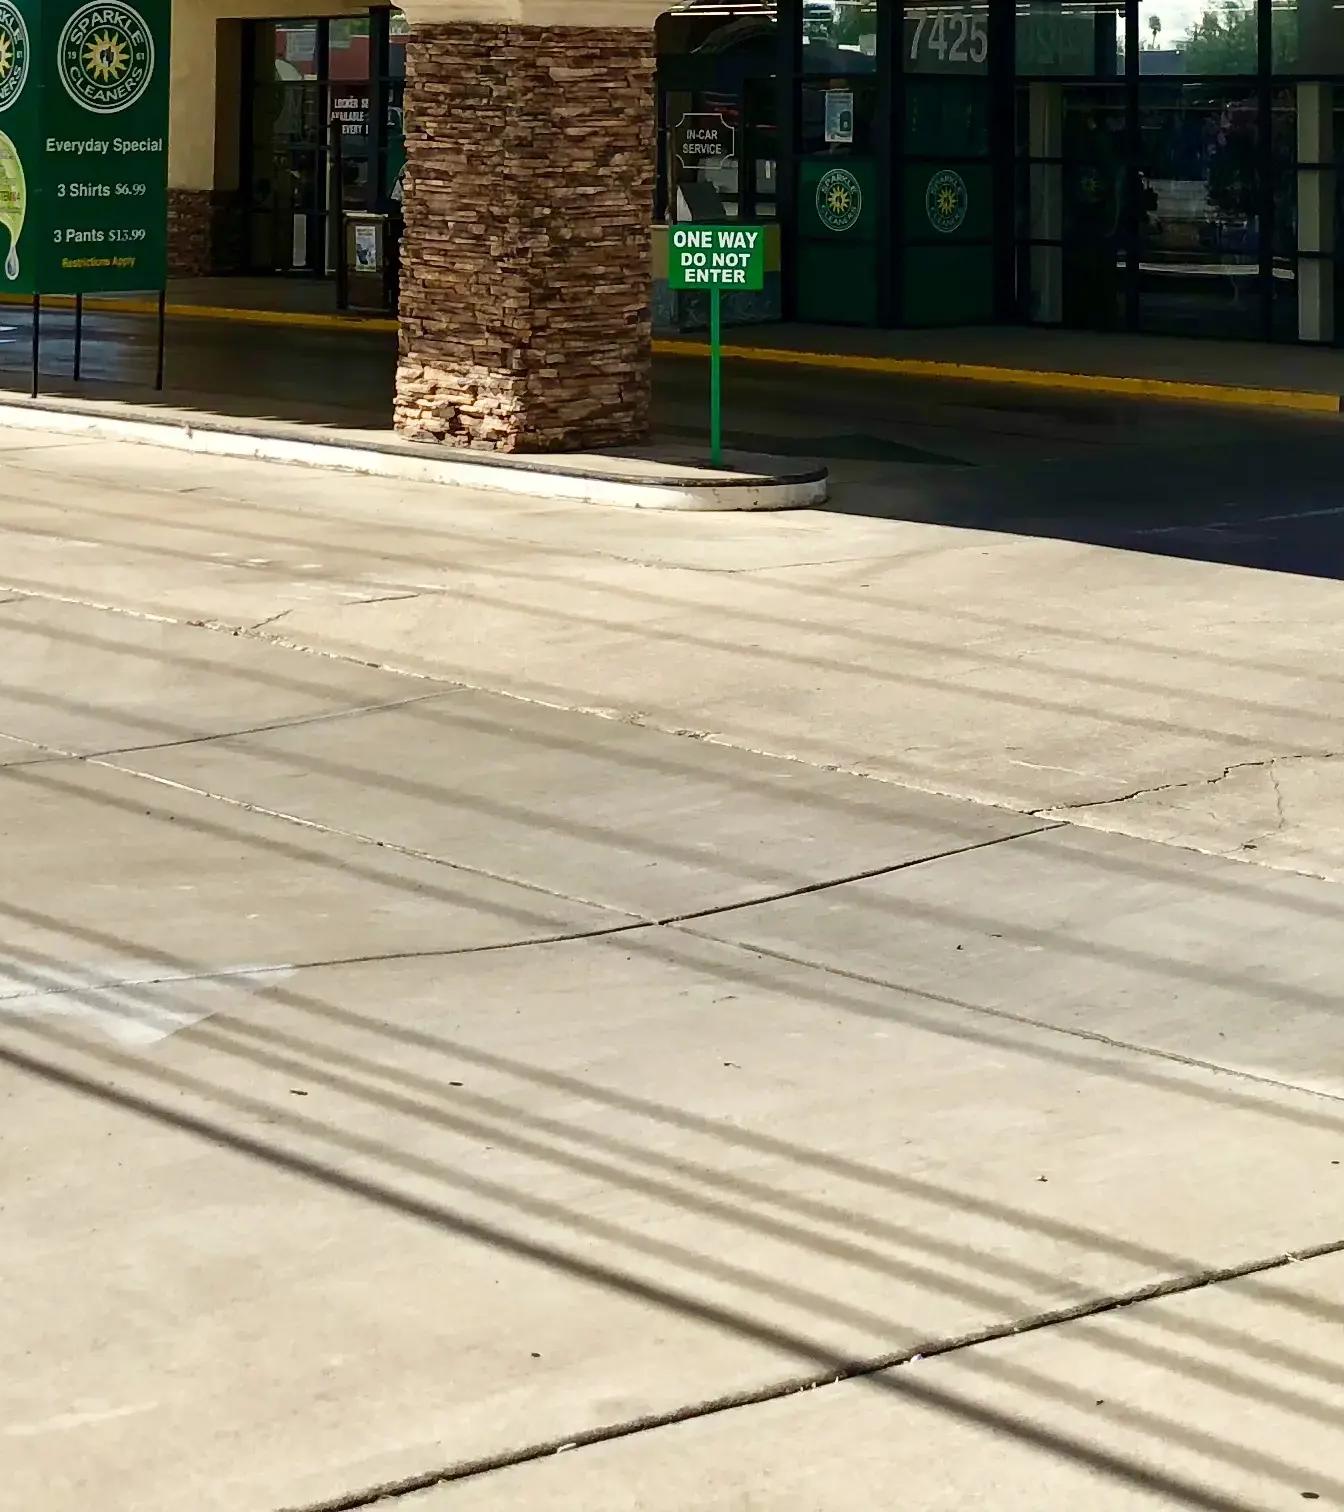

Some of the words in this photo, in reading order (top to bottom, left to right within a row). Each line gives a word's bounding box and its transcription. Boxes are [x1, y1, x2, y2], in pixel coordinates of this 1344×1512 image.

[70, 9, 144, 47] SPARKLE
[907, 10, 988, 63] 7425
[70, 66, 143, 102] CLEANERS
[686, 129, 718, 140] IN-CAR
[45, 137, 110, 155] Everyday
[113, 137, 163, 155] Special
[682, 143, 722, 155] SERVICE
[57, 183, 66, 197] 3
[69, 183, 111, 197] Shirts
[114, 183, 147, 196] $6.99
[53, 229, 63, 243] 3
[65, 228, 105, 242] Pants
[673, 231, 713, 248] ONE
[717, 231, 758, 249] WAY
[680, 252, 707, 267] DO
[712, 252, 751, 267] NOT
[684, 268, 746, 283] ENTER
